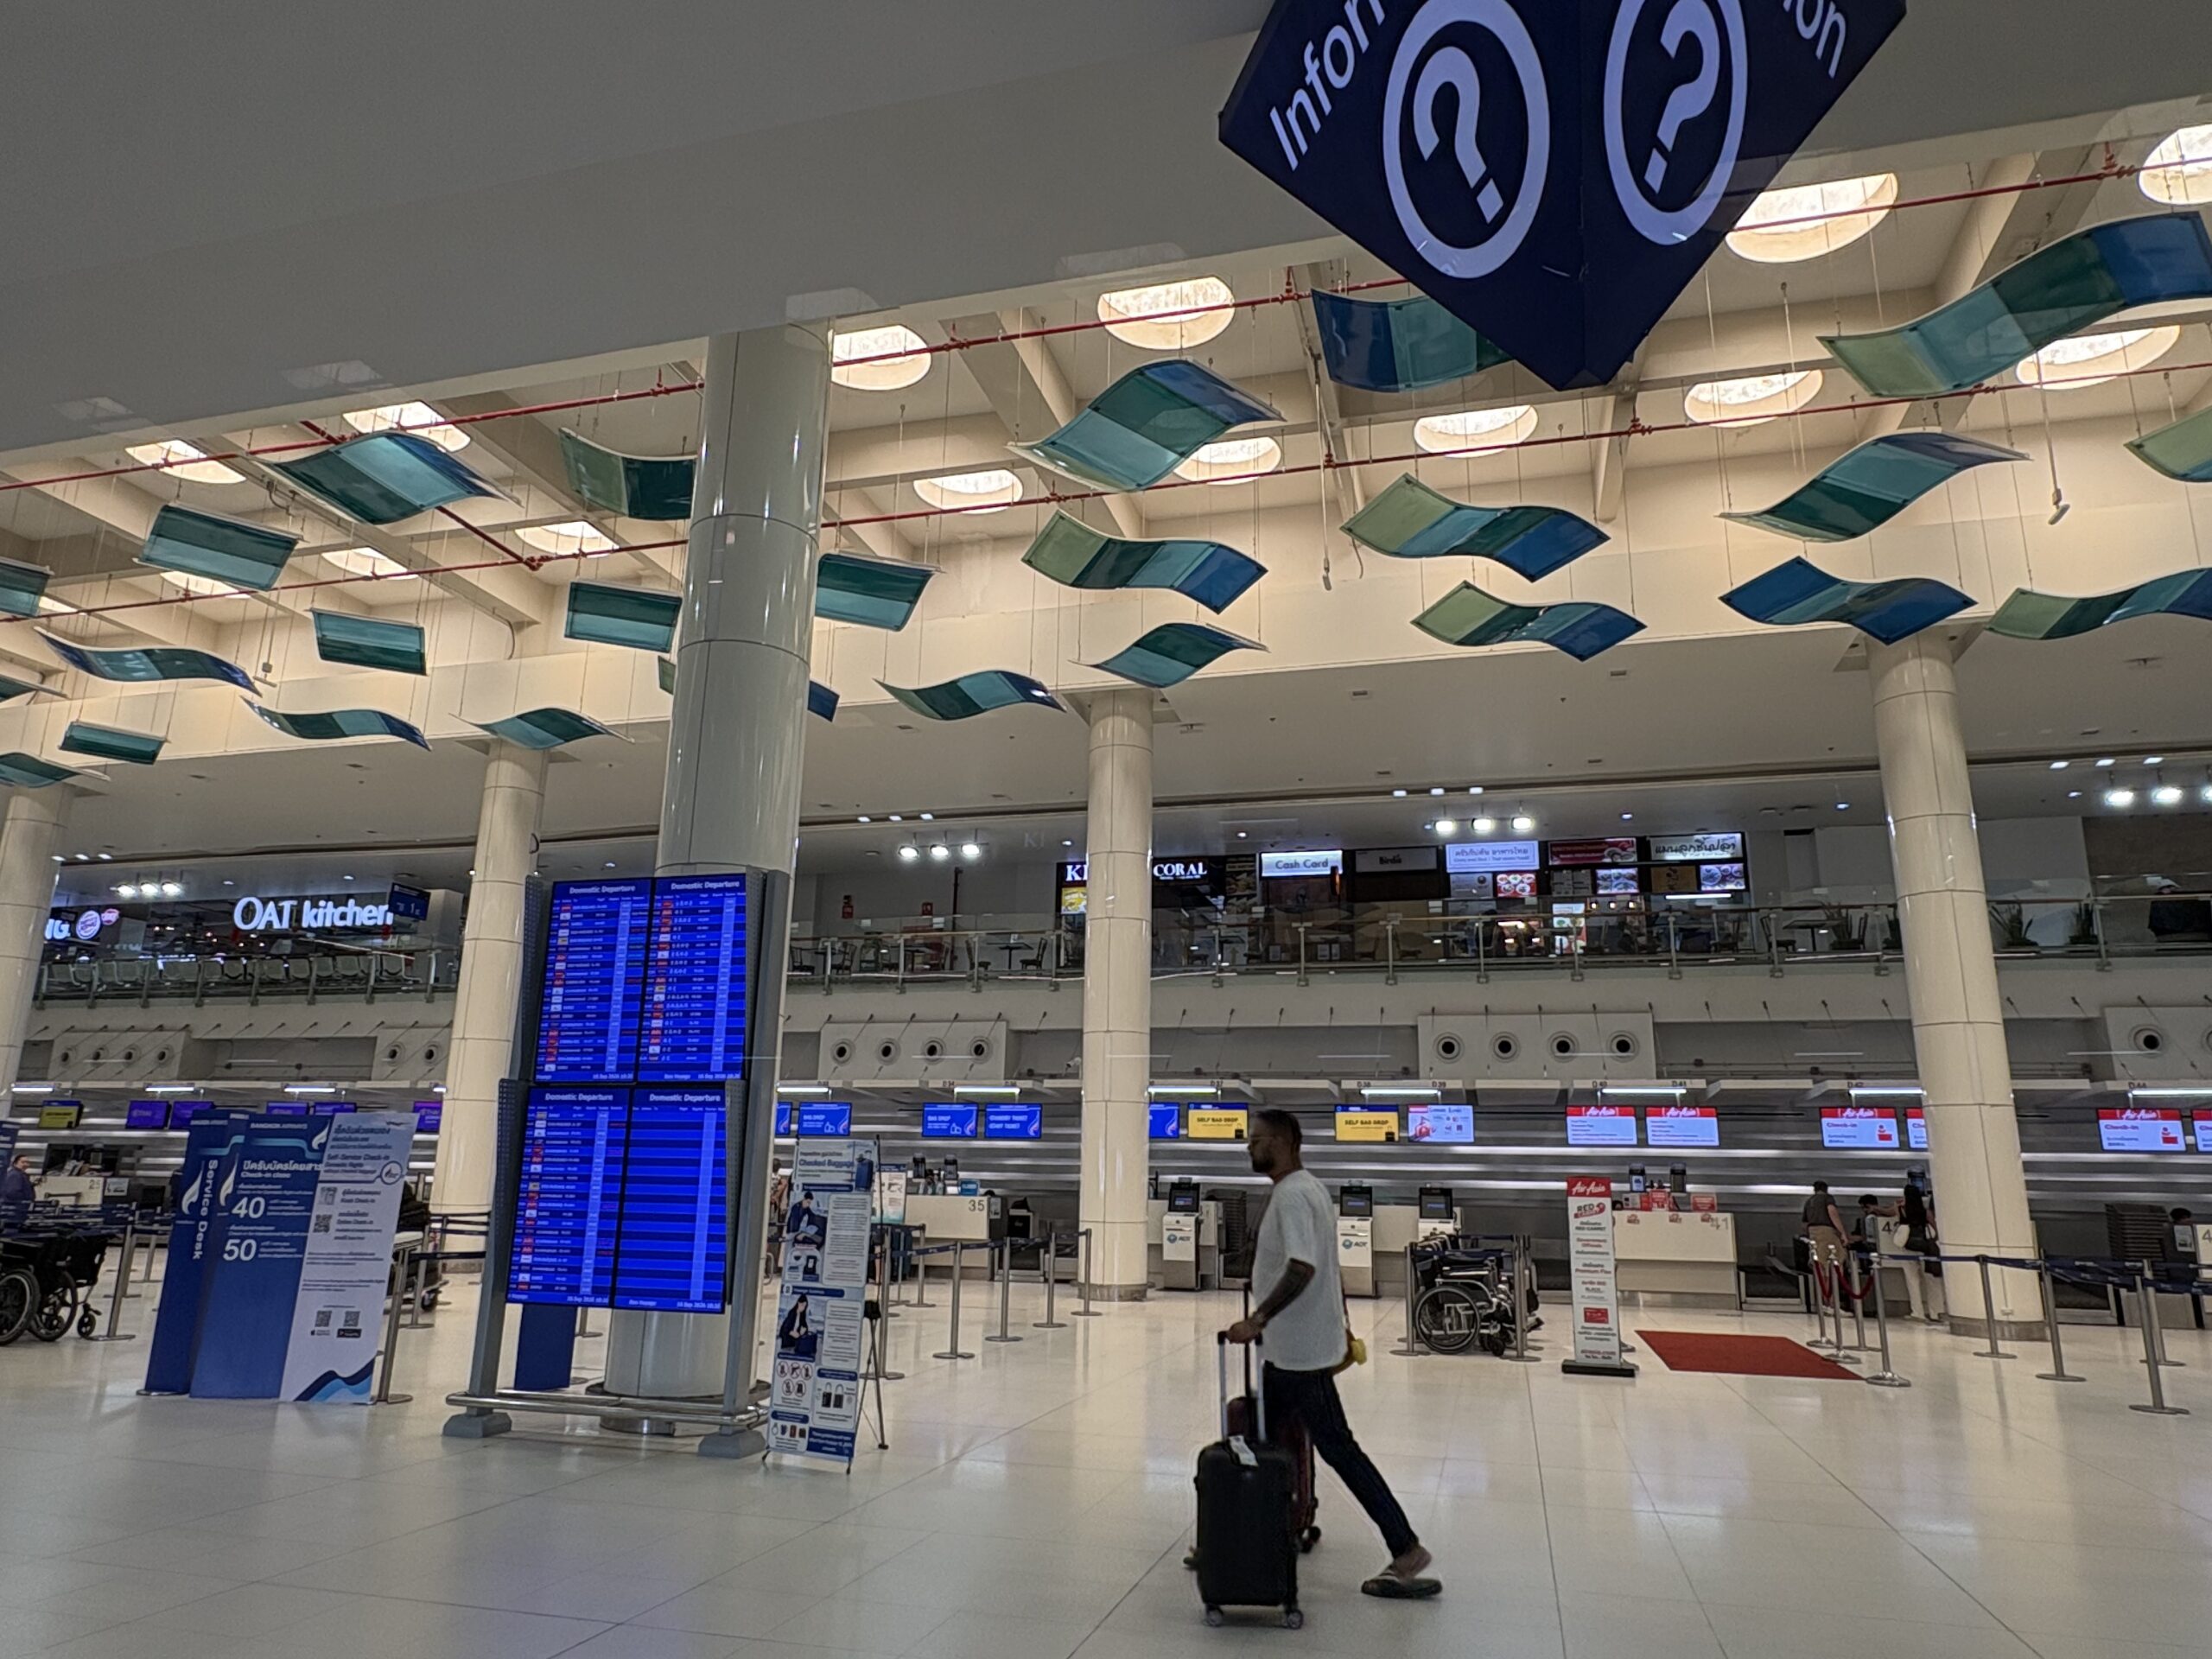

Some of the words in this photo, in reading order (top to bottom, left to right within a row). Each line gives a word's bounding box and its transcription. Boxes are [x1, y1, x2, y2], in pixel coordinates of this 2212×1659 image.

[1783, 0, 1847, 79] on
[1269, 0, 1385, 172] Infor
[1153, 861, 1207, 877] CORAL
[1275, 859, 1300, 870] Cash
[1303, 858, 1329, 868] Card
[601, 885, 636, 893] Departure
[704, 880, 741, 890] Departure
[233, 896, 297, 931] OAT
[302, 899, 393, 928] kitchen
[544, 1092, 577, 1102] Domestic
[578, 1093, 613, 1103] Departure
[649, 1093, 682, 1103] Domestic
[683, 1094, 721, 1103] Departure
[199, 1159, 219, 1217] Service
[231, 1196, 265, 1218] 40
[968, 1199, 985, 1212] 35
[193, 1220, 208, 1260] Desk
[222, 1238, 257, 1262] 50
